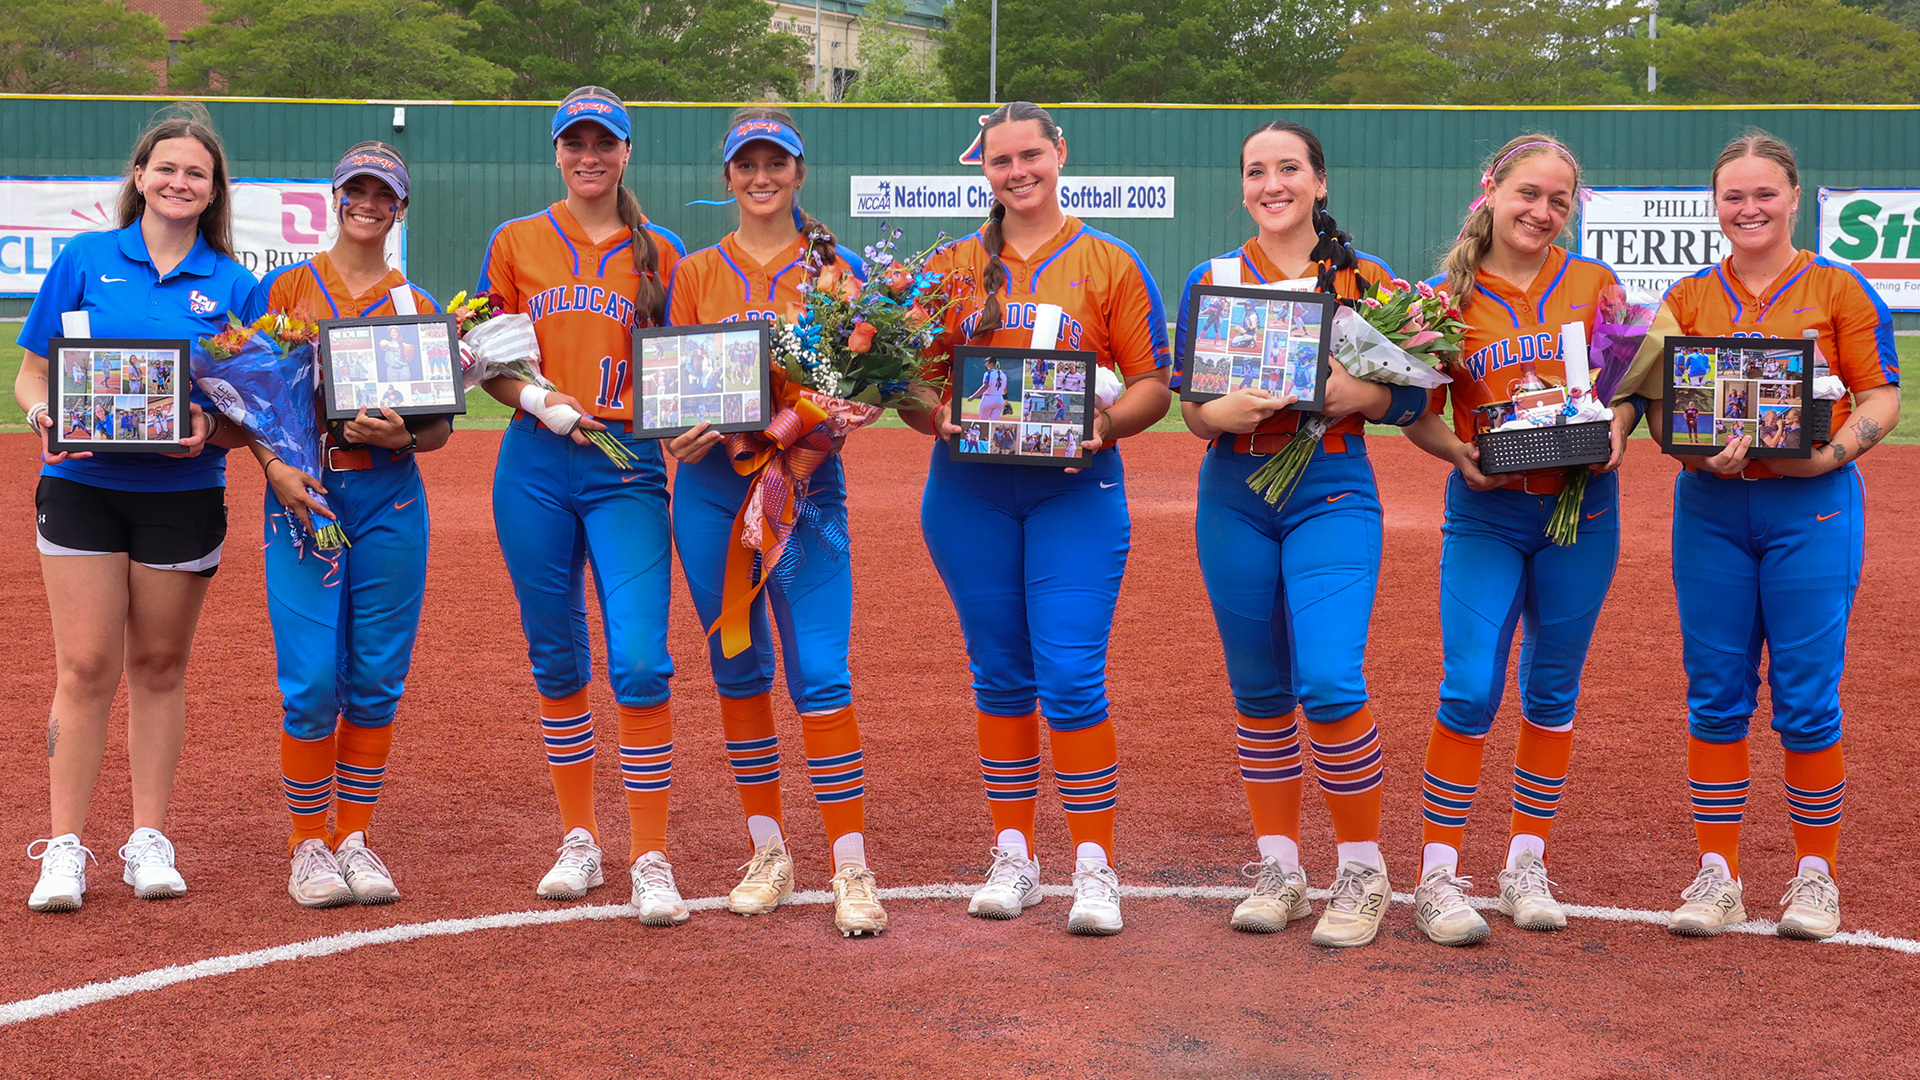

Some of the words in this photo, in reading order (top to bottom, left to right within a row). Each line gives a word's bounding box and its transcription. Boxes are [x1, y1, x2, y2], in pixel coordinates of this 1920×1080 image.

[857, 197, 891, 210] NCCAA
[895, 186, 961, 208] National
[967, 186, 996, 208] Cha
[1060, 186, 1121, 208] Softball
[1127, 186, 1166, 208] 2003
[1587, 229, 1727, 265] TERRE
[234, 251, 258, 272] ED
[1621, 278, 1674, 291] STRICT
[188, 289, 219, 313] LCU
[527, 285, 641, 337] WILDCATS
[960, 302, 1082, 350] WDCTS
[1465, 332, 1565, 382] WILDC
[205, 384, 229, 404] OLE
[596, 356, 628, 409] 11
[217, 394, 238, 413] ODS
